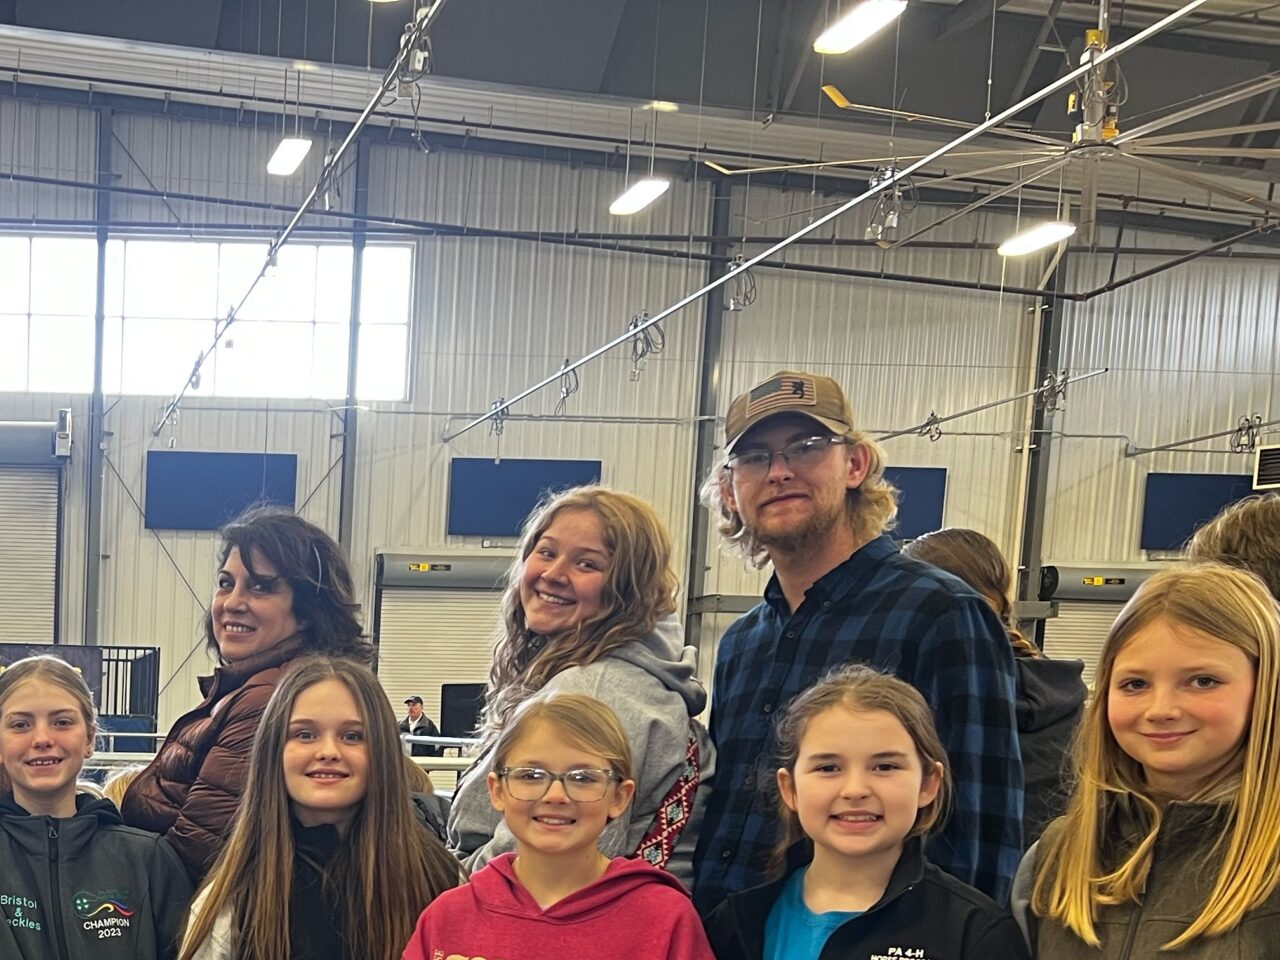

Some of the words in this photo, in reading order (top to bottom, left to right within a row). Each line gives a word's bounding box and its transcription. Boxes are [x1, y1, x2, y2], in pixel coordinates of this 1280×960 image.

[0, 895, 38, 910] Bristol
[14, 907, 24, 918] &
[6, 917, 42, 931] eckles
[83, 918, 130, 931] CHAMPION
[98, 928, 122, 939] 2023
[887, 947, 903, 956] PA
[904, 948, 925, 958] 4-H
